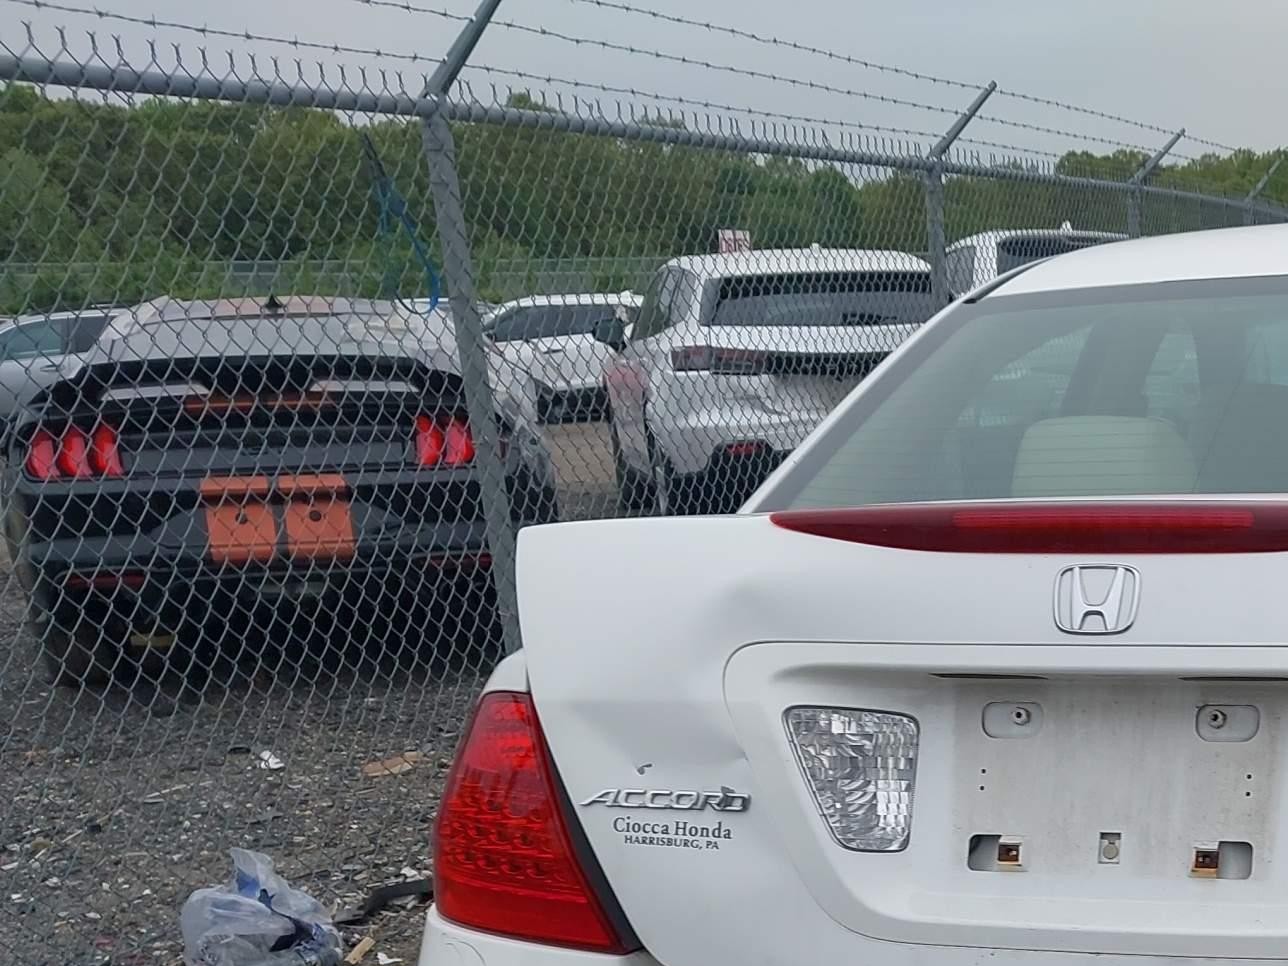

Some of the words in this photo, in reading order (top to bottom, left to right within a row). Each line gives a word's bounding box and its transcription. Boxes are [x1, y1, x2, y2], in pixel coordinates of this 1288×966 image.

[578, 787, 752, 812] ACCORD
[613, 816, 670, 835] Ciocca
[674, 821, 732, 840] Honda
[624, 835, 703, 850] HARRISBURG,
[705, 840, 720, 850] PA
